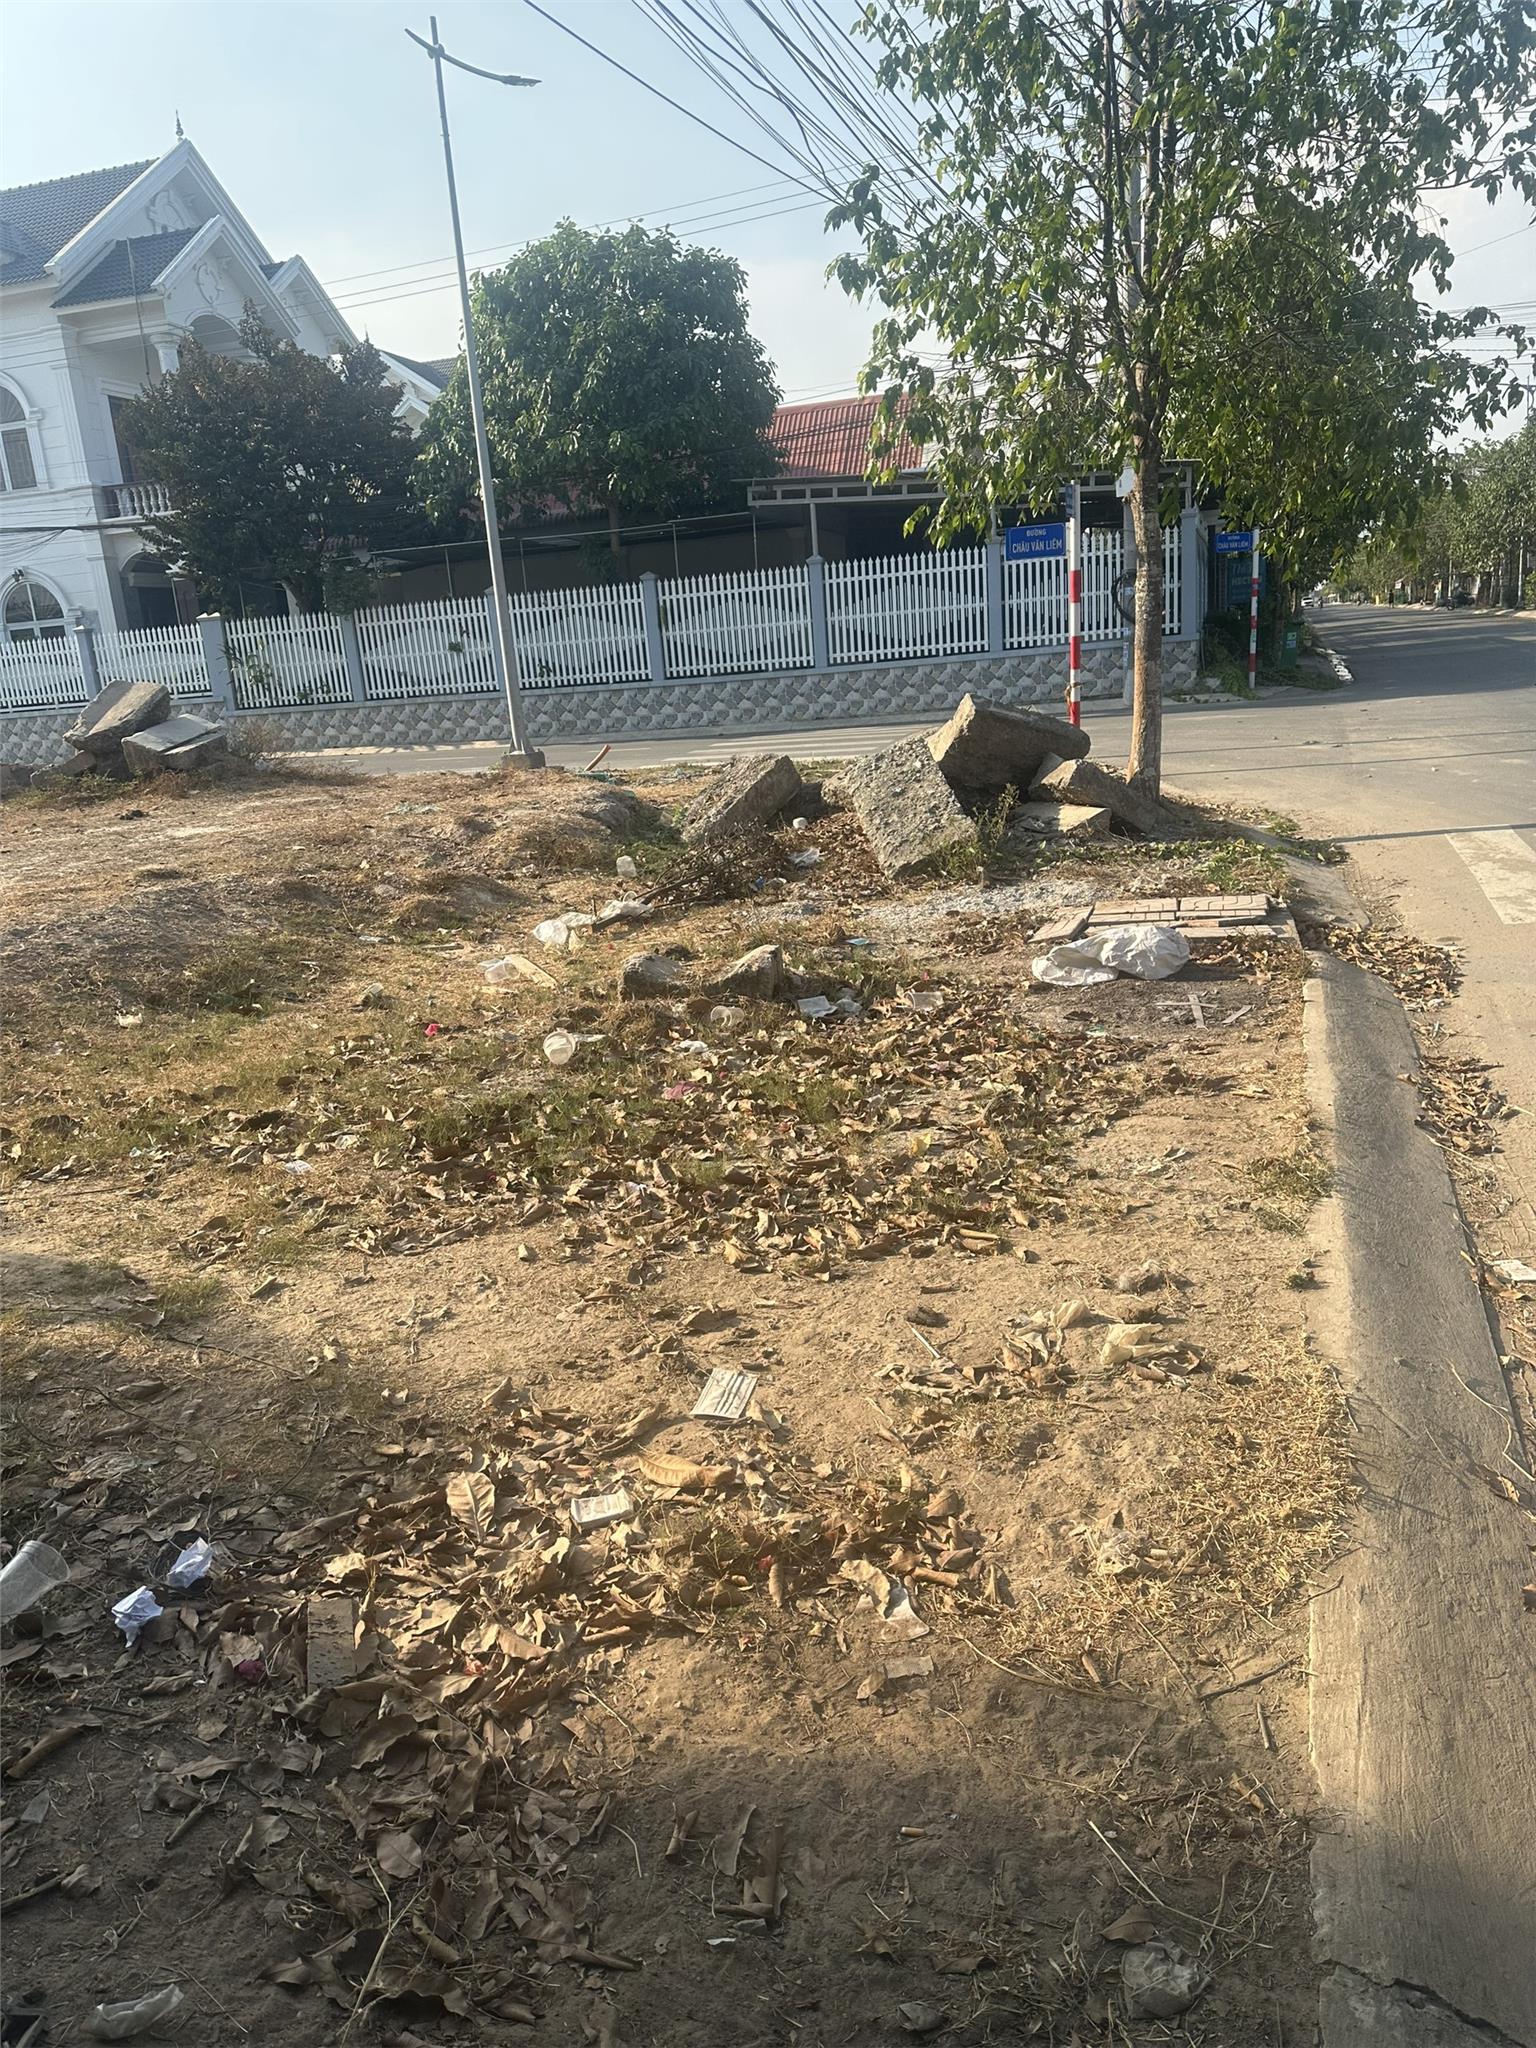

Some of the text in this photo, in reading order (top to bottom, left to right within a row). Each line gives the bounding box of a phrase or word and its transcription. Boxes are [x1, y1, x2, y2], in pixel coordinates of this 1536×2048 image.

[1026, 527, 1047, 537] ĐƯỜNG
[1012, 537, 1063, 553] CHÂU VĂN LIÊM
